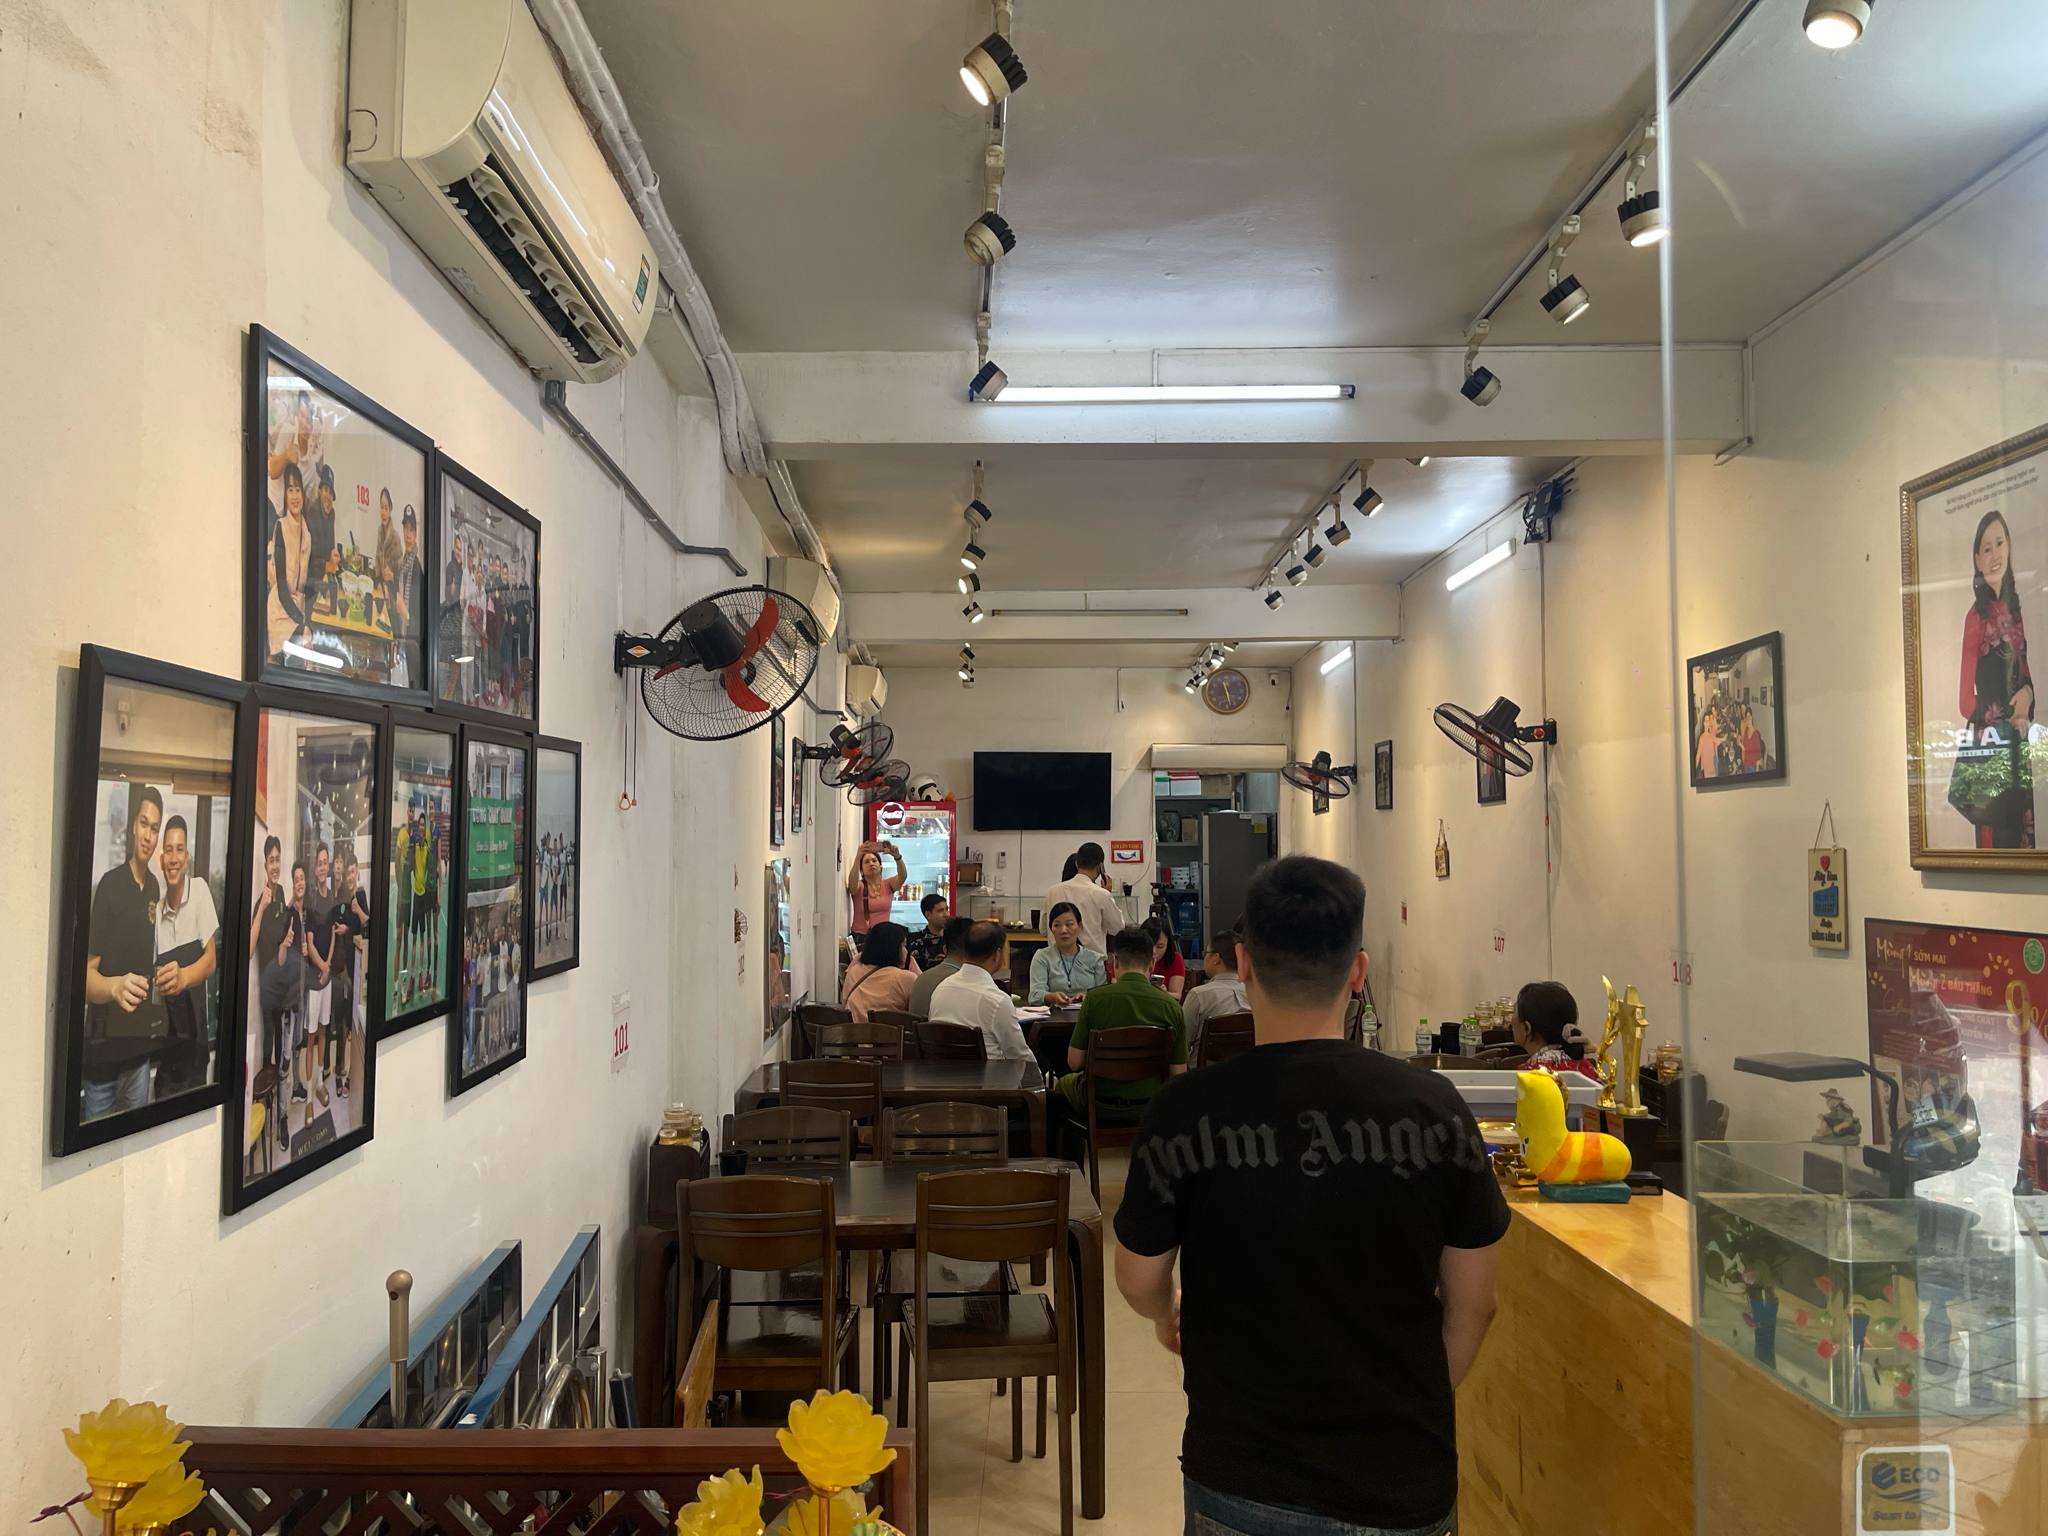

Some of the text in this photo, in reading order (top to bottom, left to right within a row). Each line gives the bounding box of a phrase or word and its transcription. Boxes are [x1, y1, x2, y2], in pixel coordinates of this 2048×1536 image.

[357, 484, 369, 506] 103
[1494, 936, 1504, 953] 107
[614, 1021, 629, 1057] 101
[1900, 1467, 1940, 1483] ECO
